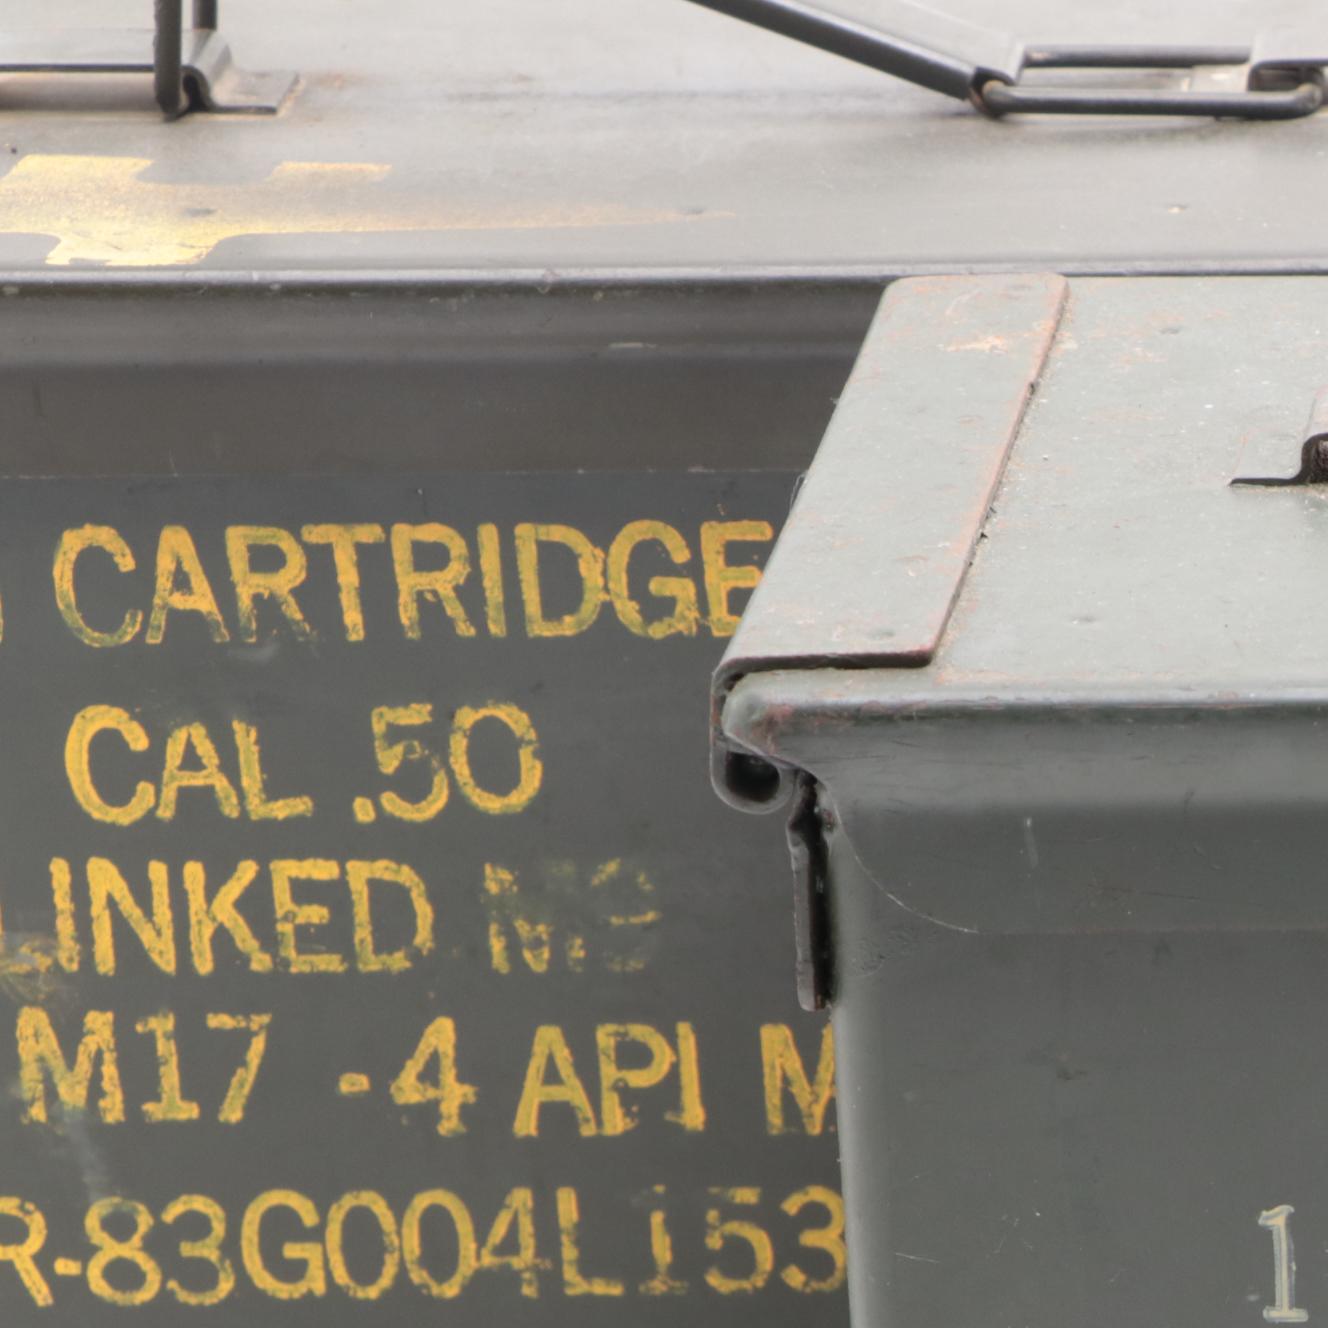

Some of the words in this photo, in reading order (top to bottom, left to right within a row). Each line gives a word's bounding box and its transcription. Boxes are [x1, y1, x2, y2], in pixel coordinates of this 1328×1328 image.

[53, 521, 774, 647] CARTRIDGE
[65, 705, 313, 825] CAL
[353, 703, 543, 823] .50
[16, 1006, 271, 1124] M17
[513, 1022, 706, 1137] API
